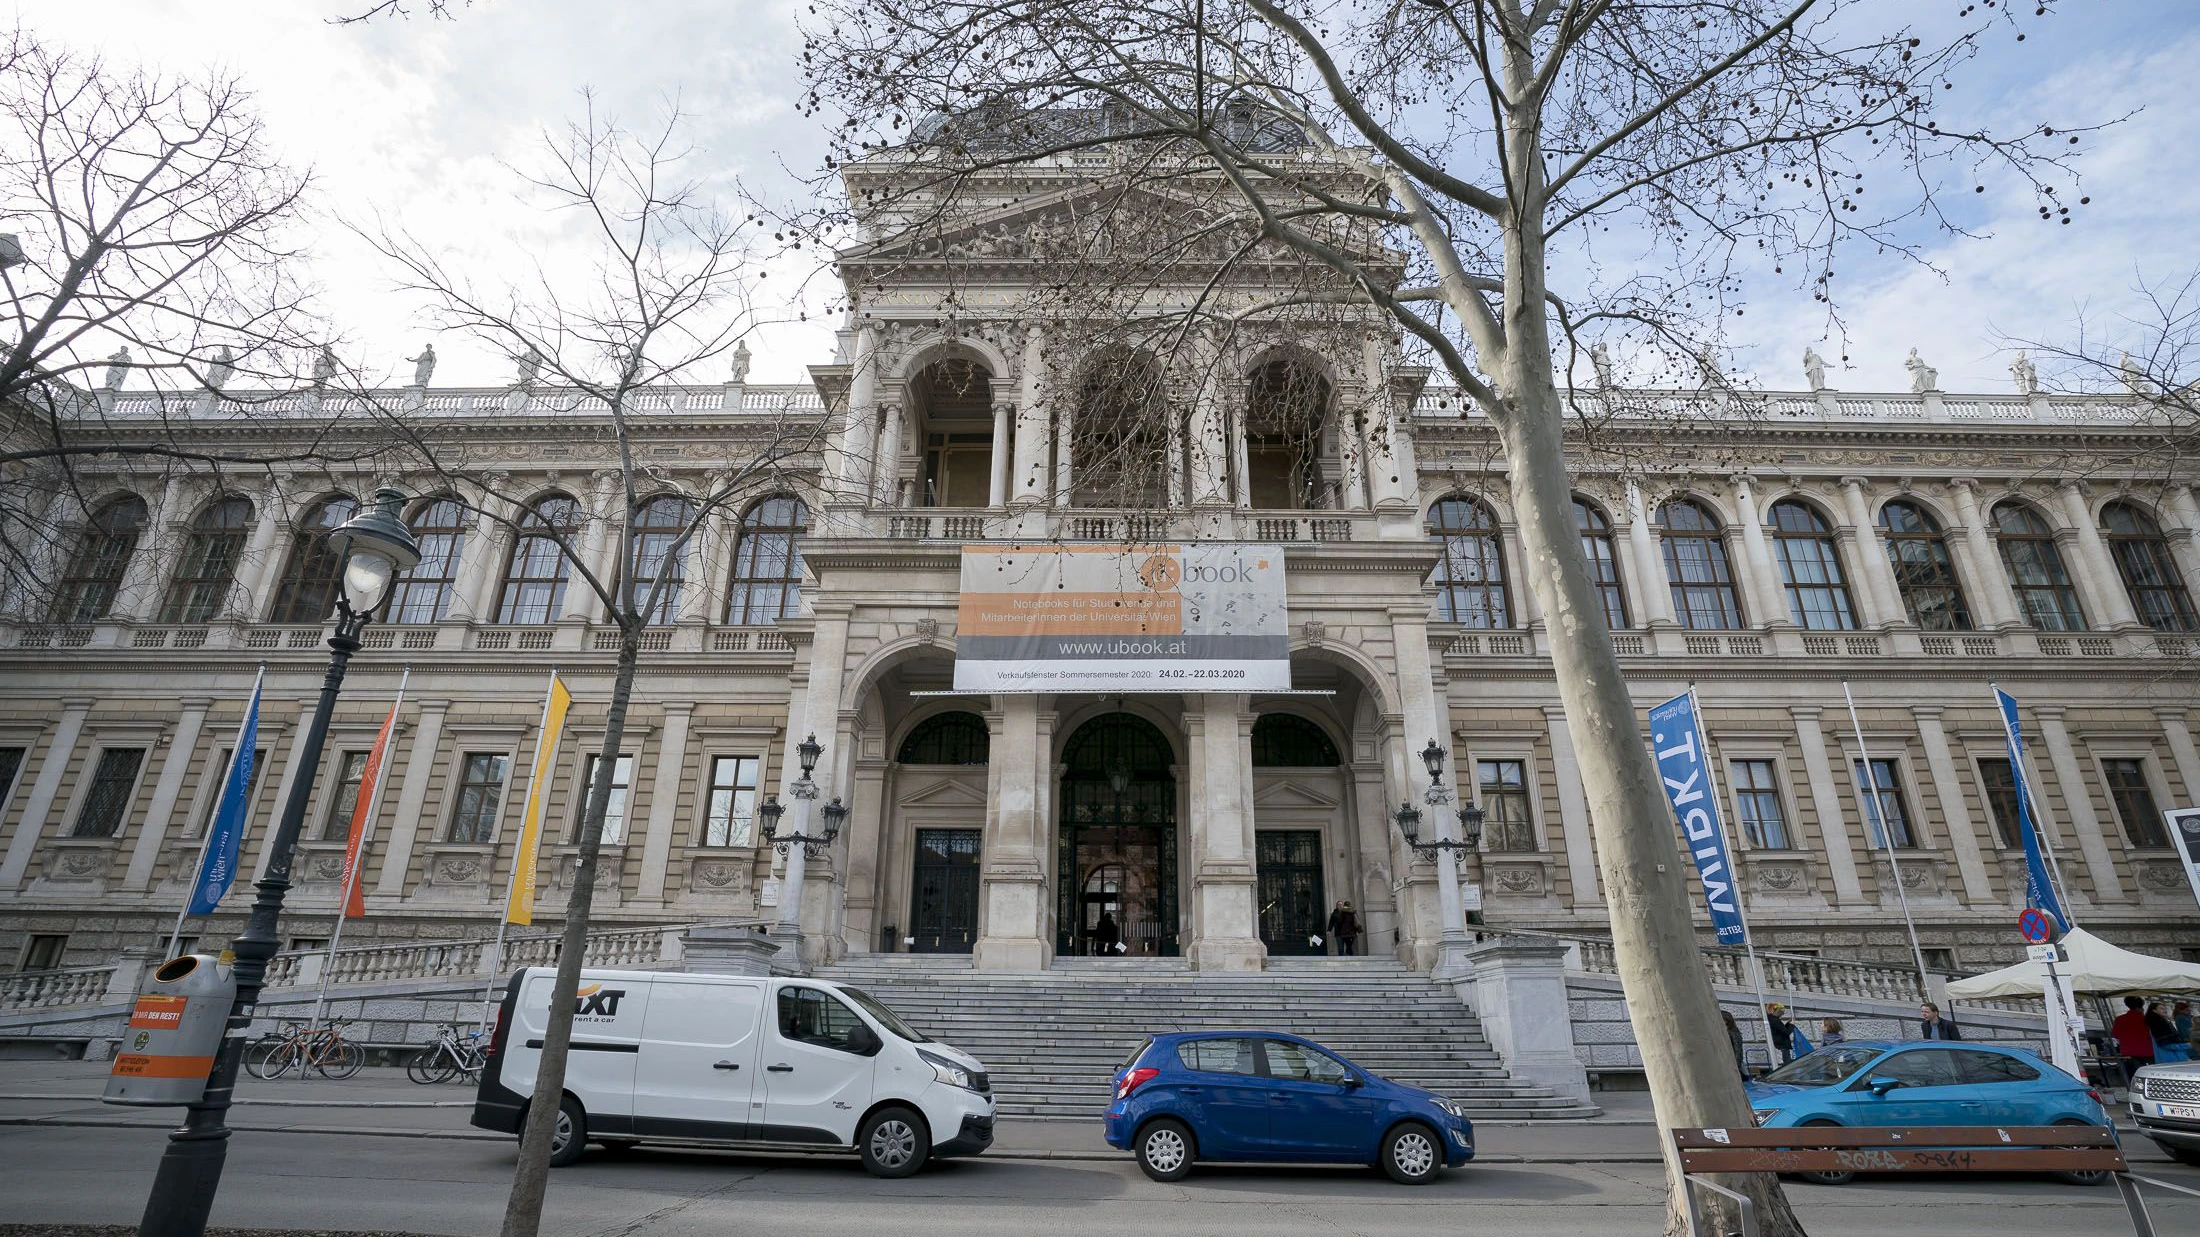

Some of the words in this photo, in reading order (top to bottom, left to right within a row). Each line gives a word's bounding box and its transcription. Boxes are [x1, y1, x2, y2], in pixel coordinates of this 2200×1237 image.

[1013, 599, 1069, 609] Notebooks
[1072, 599, 1085, 608] für
[1156, 599, 1176, 608] und
[981, 612, 1067, 622] MitarbeiterInnen
[1069, 613, 1087, 621] der
[1090, 612, 1147, 622] Universität
[1149, 612, 1176, 622] Wien
[1058, 639, 1187, 655] www.ubook.at
[997, 670, 1059, 680] Verkaufsfenster
[1060, 670, 1129, 680] Sommersemester
[1131, 670, 1153, 679] 2020:
[548, 988, 626, 1016] IXT
[159, 1012, 180, 1021] REST!
